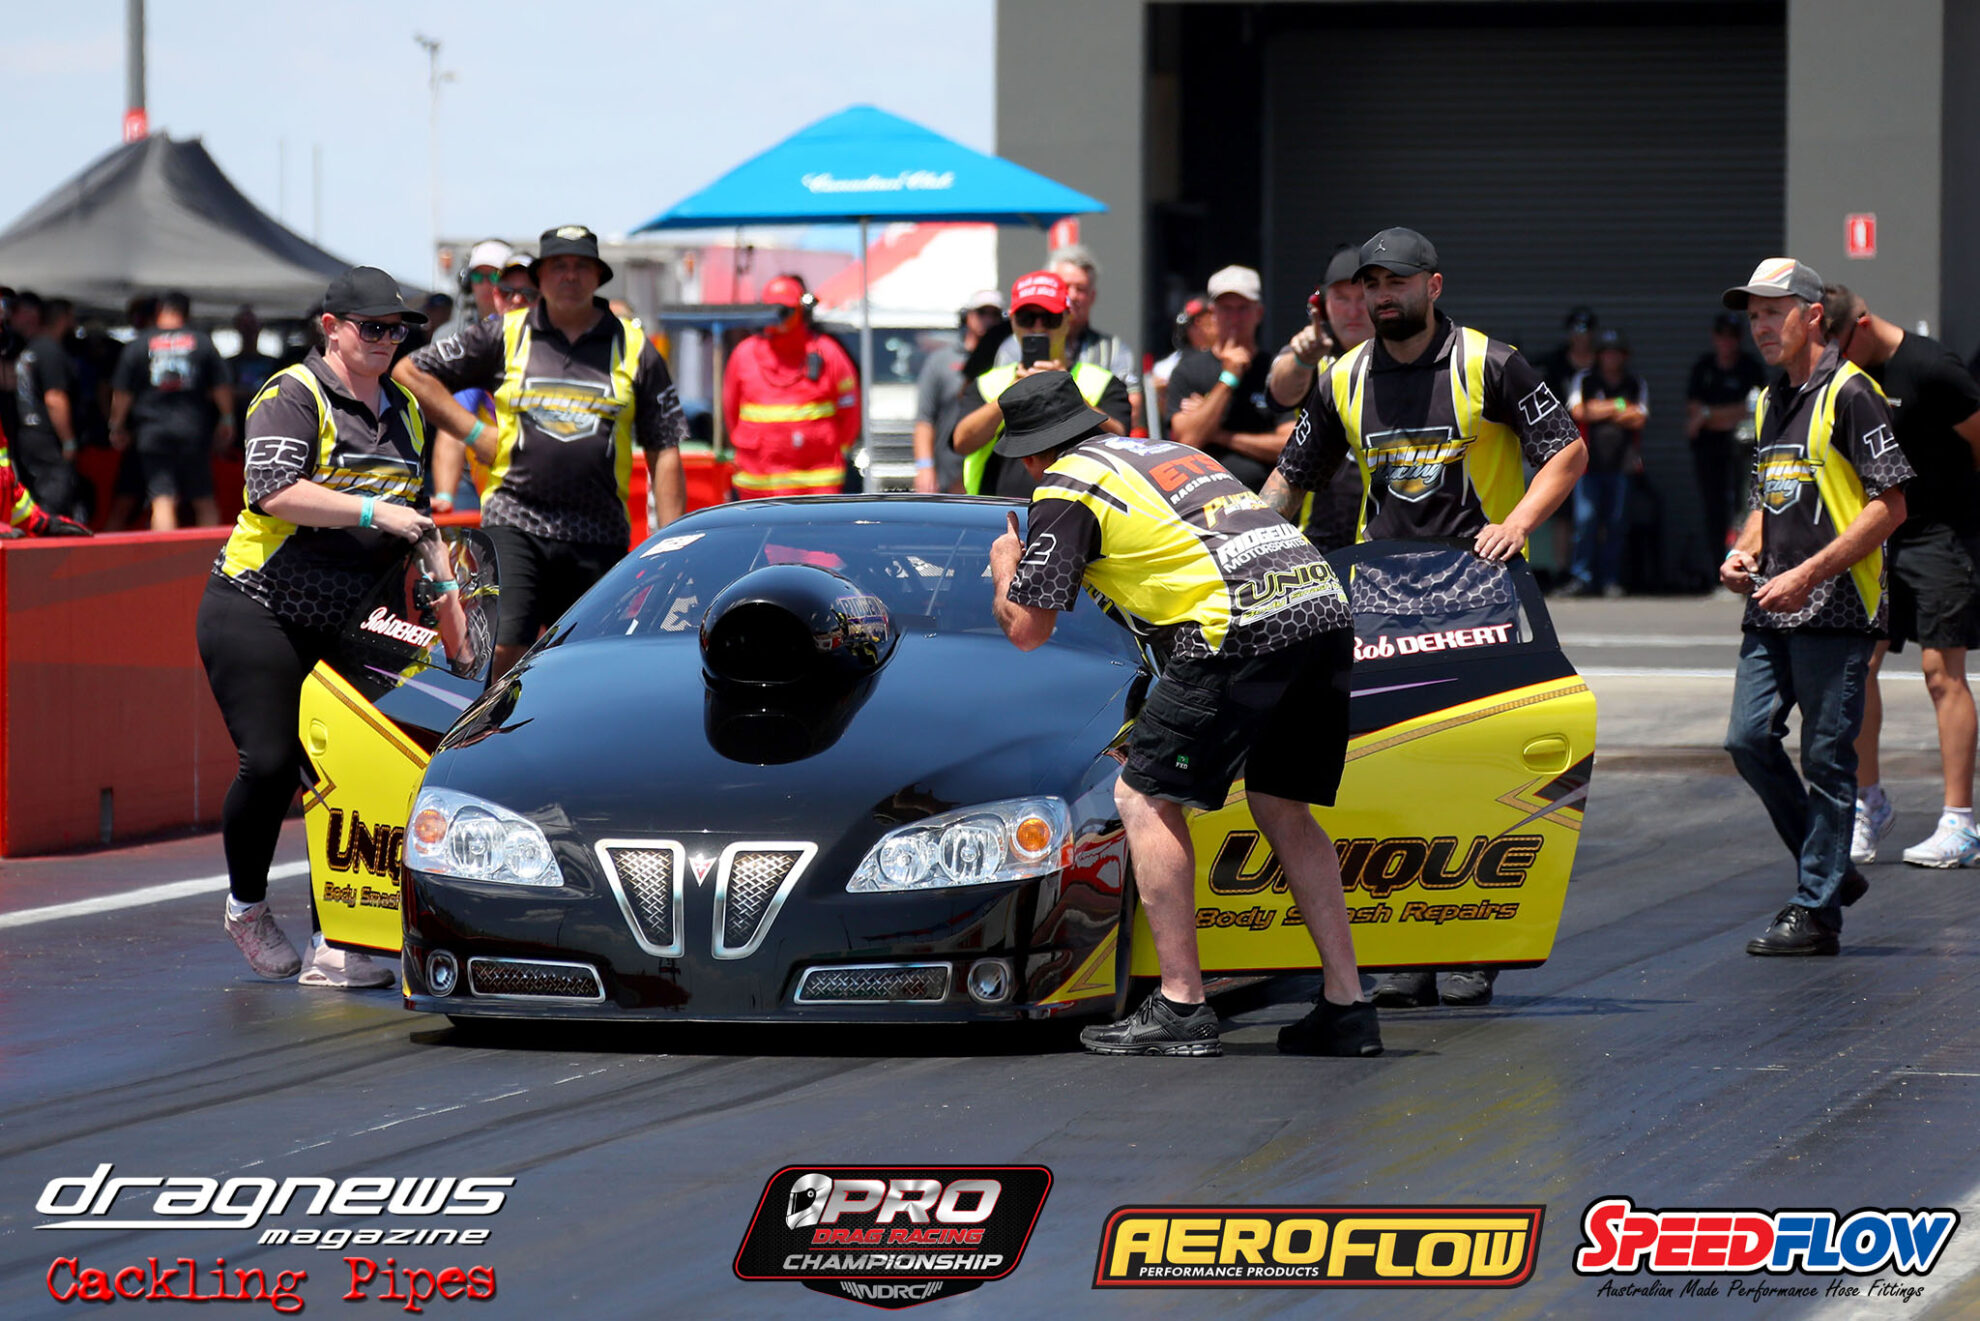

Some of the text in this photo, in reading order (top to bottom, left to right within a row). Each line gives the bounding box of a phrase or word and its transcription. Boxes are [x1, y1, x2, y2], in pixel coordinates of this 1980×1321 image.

[1395, 622, 1514, 656] DEKERT
[1194, 906, 1277, 931] Body
[1399, 899, 1521, 926] Repairs
